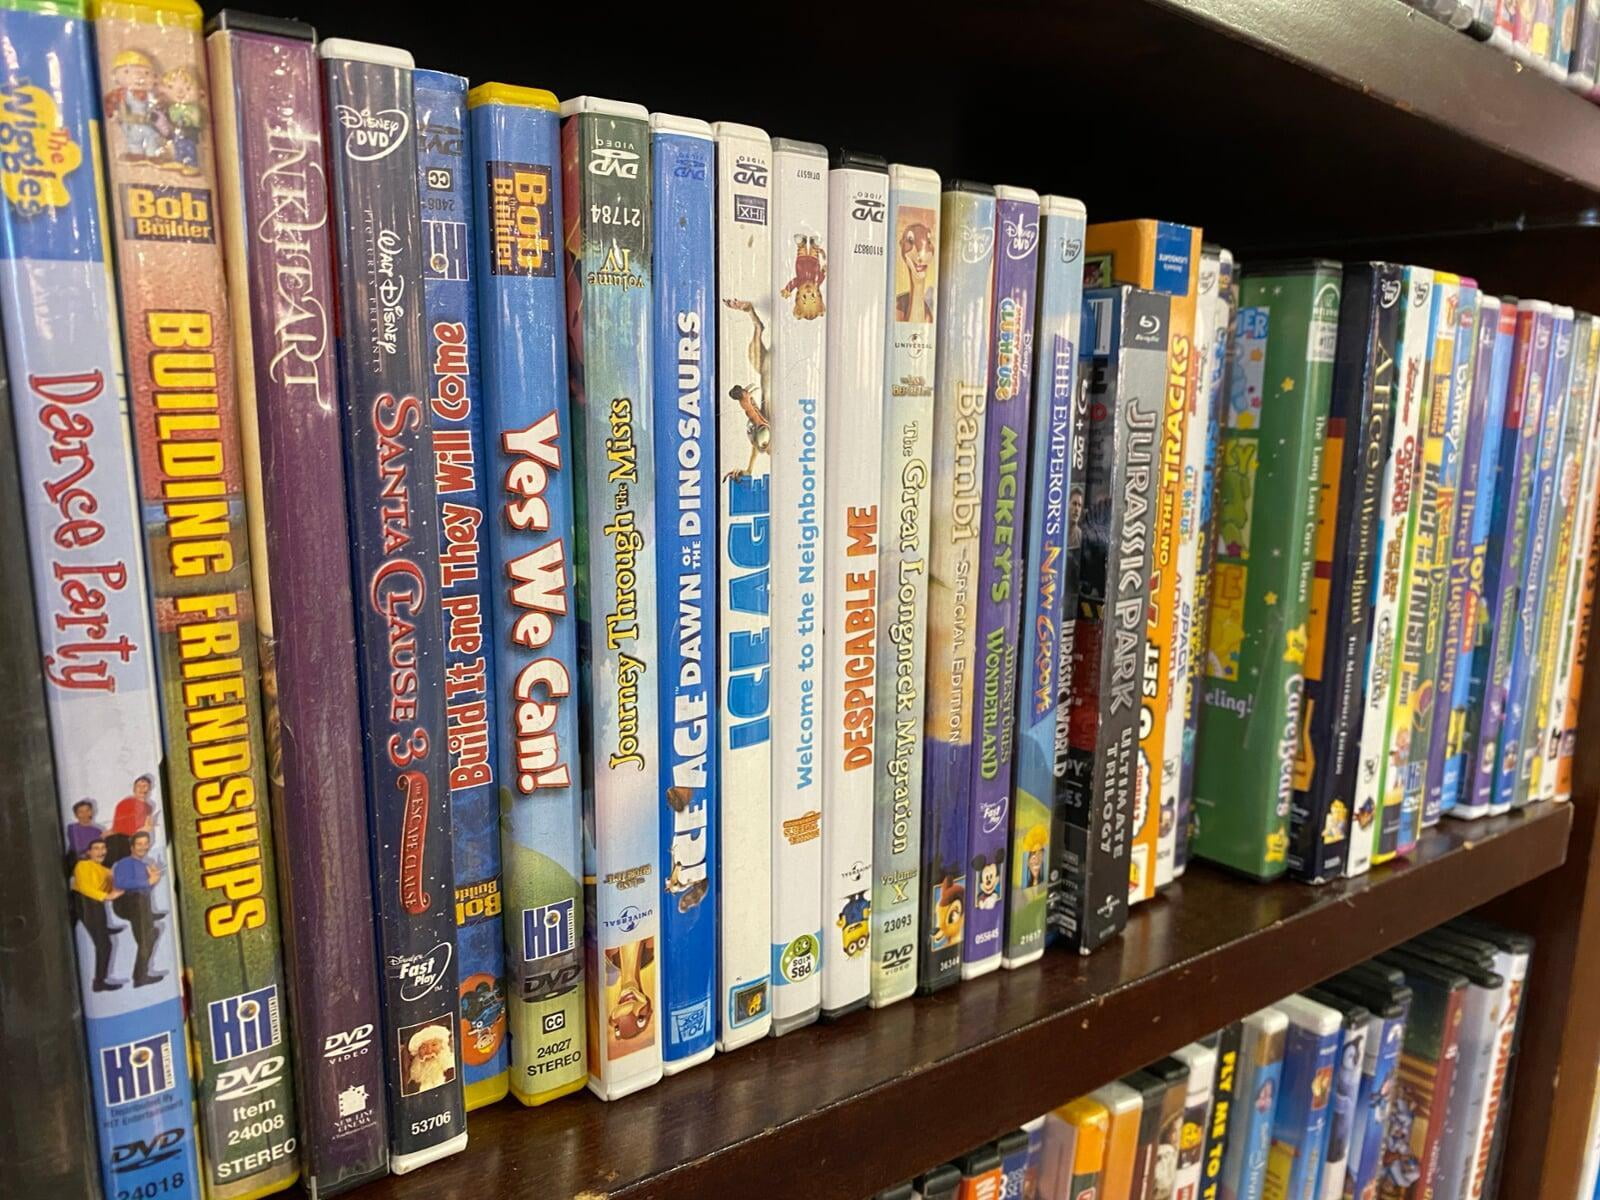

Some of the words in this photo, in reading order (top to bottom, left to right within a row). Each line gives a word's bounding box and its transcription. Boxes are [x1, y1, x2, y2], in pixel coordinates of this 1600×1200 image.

[335, 103, 399, 136] Disney
[355, 131, 390, 149] DVD
[596, 139, 636, 151] VIDEO
[428, 169, 451, 189] CC
[588, 158, 641, 180] DVD
[673, 166, 706, 181] DVD
[733, 170, 768, 188] DVD
[737, 155, 766, 167] VIDEO
[129, 187, 209, 222] Bob
[513, 169, 550, 270] Bob
[590, 203, 641, 228] 21784
[851, 207, 885, 224] DVD
[857, 191, 883, 200] VIDEO
[136, 218, 212, 240] Builder
[493, 176, 514, 271] Builder
[1013, 236, 1031, 251] DVD
[258, 120, 332, 411] INKHEART
[376, 229, 403, 282] Walt
[586, 271, 646, 293] volume
[600, 248, 632, 274] IV
[378, 276, 405, 354] Disney
[430, 320, 473, 422] Come
[894, 341, 933, 350] UNIVERSAL
[995, 297, 1016, 401] CLUBHOUSE
[1054, 346, 1071, 399] THE
[676, 310, 703, 538] DINOSAURS
[1161, 334, 1190, 488] TRACKS
[1315, 416, 1327, 441] The
[1366, 340, 1393, 470] Alice
[1444, 363, 1469, 465] Barney's
[28, 368, 106, 550] Dance
[144, 308, 235, 578] BUILDING
[432, 430, 476, 494] Will
[604, 397, 639, 484] Mists
[902, 420, 919, 457] The
[950, 381, 986, 544] Bambi
[1308, 446, 1323, 481] Long
[372, 392, 423, 556] SANTA
[502, 407, 562, 532] Yes
[614, 481, 630, 512] The
[797, 398, 819, 585] Neighborhood
[1045, 404, 1069, 536] EMPEROR'S
[1118, 396, 1158, 593] JURASSIC
[899, 458, 929, 553] Great
[991, 424, 1019, 604] MICKEY'S
[1162, 490, 1175, 532] THE
[1307, 486, 1319, 516] Lost
[1456, 488, 1476, 554] Three
[1509, 452, 1532, 569] MICKEY'S
[439, 502, 484, 588] They
[681, 544, 692, 567] OF
[691, 539, 701, 570] THE
[727, 472, 772, 617] AGE
[846, 504, 878, 557] ME
[1159, 534, 1171, 565] ON
[1302, 521, 1315, 556] Care
[602, 510, 646, 652] Through
[1040, 540, 1063, 611] NEW
[1298, 560, 1312, 603] Bears
[1351, 497, 1376, 625] Wonderland
[506, 537, 569, 650] We
[797, 591, 815, 637] the
[951, 559, 970, 651] SPECIAL
[1404, 567, 1431, 663] FINISH
[43, 561, 137, 693] Party
[369, 557, 426, 724] CLAUSE
[441, 594, 486, 655] and
[678, 572, 702, 688] DAWN
[888, 558, 925, 709] Longneck
[1176, 601, 1191, 682] SPACE
[1440, 556, 1471, 693] Musketeers
[445, 656, 487, 699] It
[797, 643, 815, 673] to
[842, 569, 878, 772] DESPICABLE
[1034, 613, 1057, 715] GROOVE
[1058, 618, 1077, 702] JURASSIC
[1110, 597, 1144, 716] PARK
[1141, 639, 1163, 698] SET
[608, 652, 648, 772] Journey
[726, 626, 772, 750] ICE
[948, 656, 966, 743] EDITION
[980, 625, 1005, 781] WONDERLAND
[1000, 644, 1014, 764] ADVENTURES
[387, 727, 430, 768] 3
[446, 699, 493, 792] Build
[514, 656, 572, 796] Can!
[671, 691, 709, 790] AGE
[796, 679, 815, 791] Welcome
[1053, 702, 1071, 778] WORLD
[173, 591, 268, 939] FRIENDSHIPS
[886, 720, 917, 855] Migration
[1100, 741, 1119, 853] TRILOGY
[1112, 727, 1133, 860] ULTIMATE
[405, 797, 425, 852] ESCAPE
[672, 798, 709, 888] ICE
[402, 853, 419, 909] CLAUSE
[879, 869, 917, 888] volume
[890, 881, 909, 905] X
[602, 908, 653, 928] UNIVERSAL
[883, 913, 913, 935] 23093
[398, 957, 436, 980] Fast
[413, 971, 437, 988] Play
[523, 963, 584, 990] DVD
[790, 963, 812, 982] PBS
[792, 954, 813, 968] KIDS
[881, 943, 914, 963] DVD
[884, 964, 911, 977] VIDEO
[324, 1023, 375, 1050] DVD
[536, 1038, 572, 1060] 24027
[544, 1013, 564, 1031] CC
[215, 1055, 286, 1092] DVD
[328, 1047, 369, 1065] VIDEO
[526, 1051, 582, 1079] STEREO
[1218, 1050, 1238, 1093] FLY
[227, 1115, 285, 1146] 24008
[232, 1097, 277, 1122] Item
[410, 1110, 453, 1136] 53706
[1211, 1101, 1230, 1140] ME
[111, 1128, 185, 1164] DVD
[216, 1137, 297, 1179] STEREO
[1206, 1142, 1224, 1179] TO
